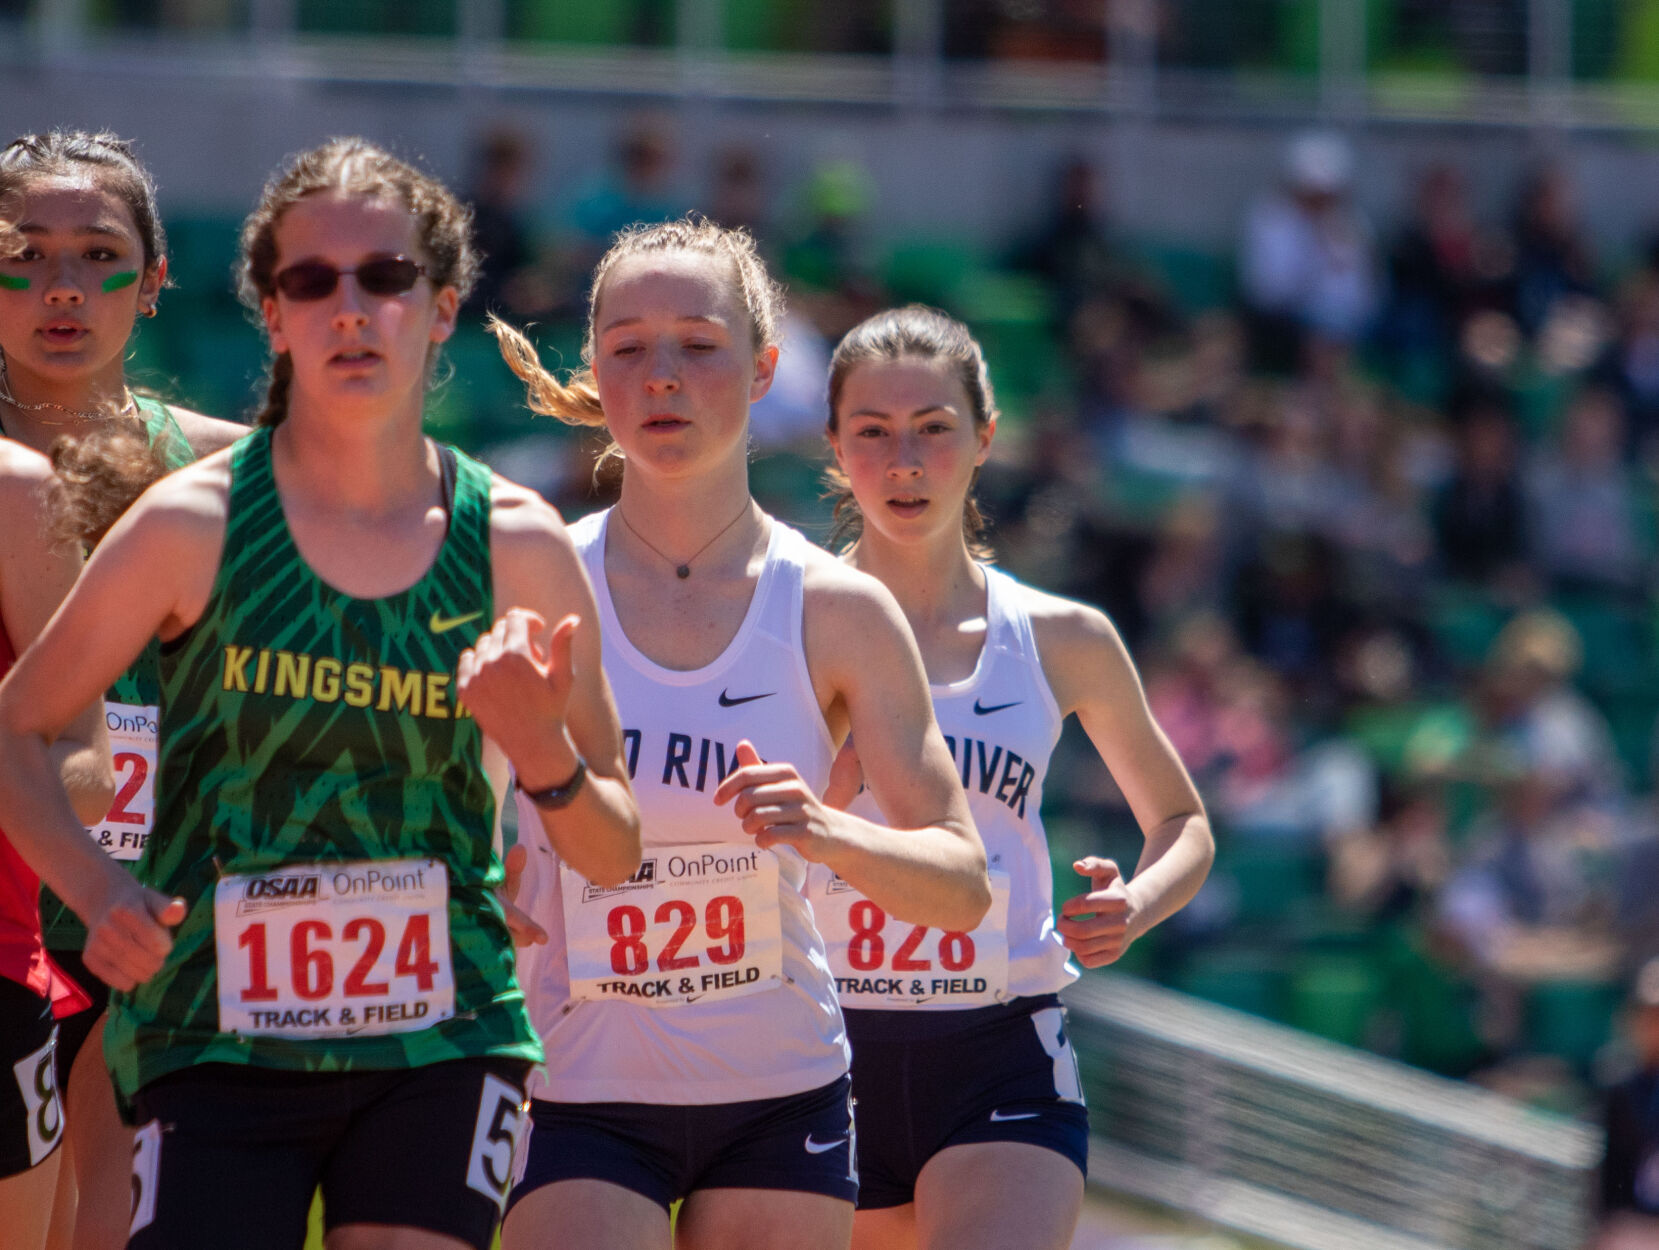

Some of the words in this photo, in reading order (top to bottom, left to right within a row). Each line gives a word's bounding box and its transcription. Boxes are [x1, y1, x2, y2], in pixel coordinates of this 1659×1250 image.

[223, 644, 473, 720] KINGSME
[106, 712, 158, 733] OnPo
[662, 732, 767, 793] RIV
[98, 830, 113, 846] &
[668, 851, 758, 877] OnPoint
[246, 876, 318, 899] OSAA
[333, 869, 424, 895] OnPoint
[607, 896, 746, 976] 829
[238, 914, 439, 1003] 1624
[596, 978, 672, 998] TRACK
[678, 977, 695, 994] &
[701, 967, 760, 991] FIELD
[834, 978, 903, 995] TRACK
[910, 978, 925, 995] &
[931, 978, 987, 995] FIELD
[250, 1007, 331, 1029] TRACK
[339, 1008, 356, 1025] &
[364, 1002, 429, 1024] FIELD
[481, 1095, 519, 1198] 5
